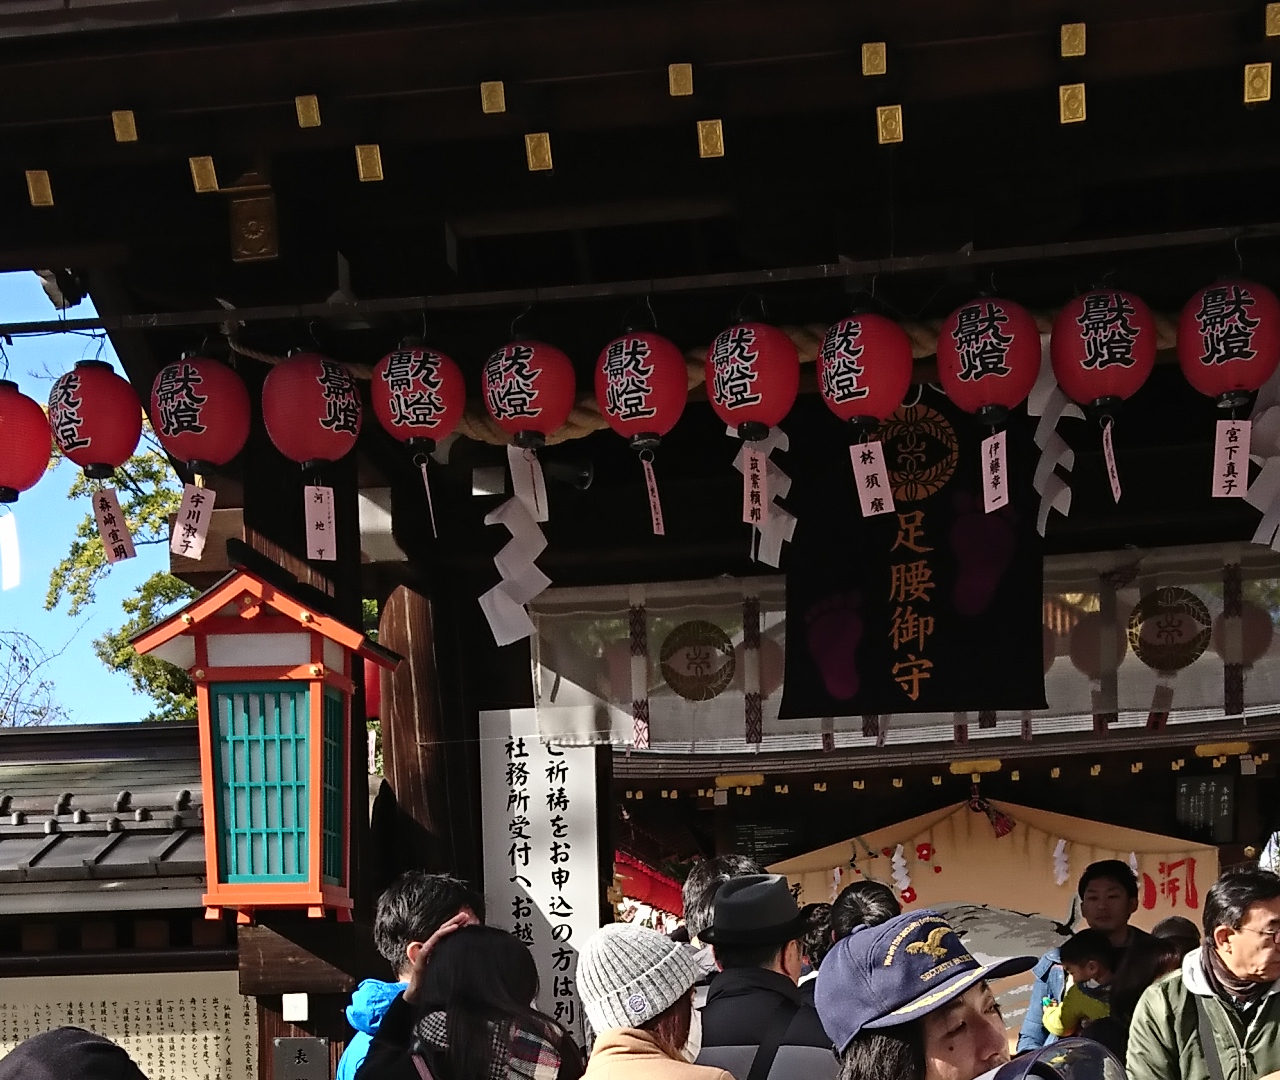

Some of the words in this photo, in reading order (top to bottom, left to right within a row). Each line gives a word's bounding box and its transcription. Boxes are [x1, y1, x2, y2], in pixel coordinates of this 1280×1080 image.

[988, 442, 1003, 505] 伊藤幸一
[1222, 425, 1242, 494] 宮下真子
[178, 493, 206, 553] 宇川淑子
[888, 510, 936, 702] 足腰御守
[920, 960, 954, 981] SECURITY
